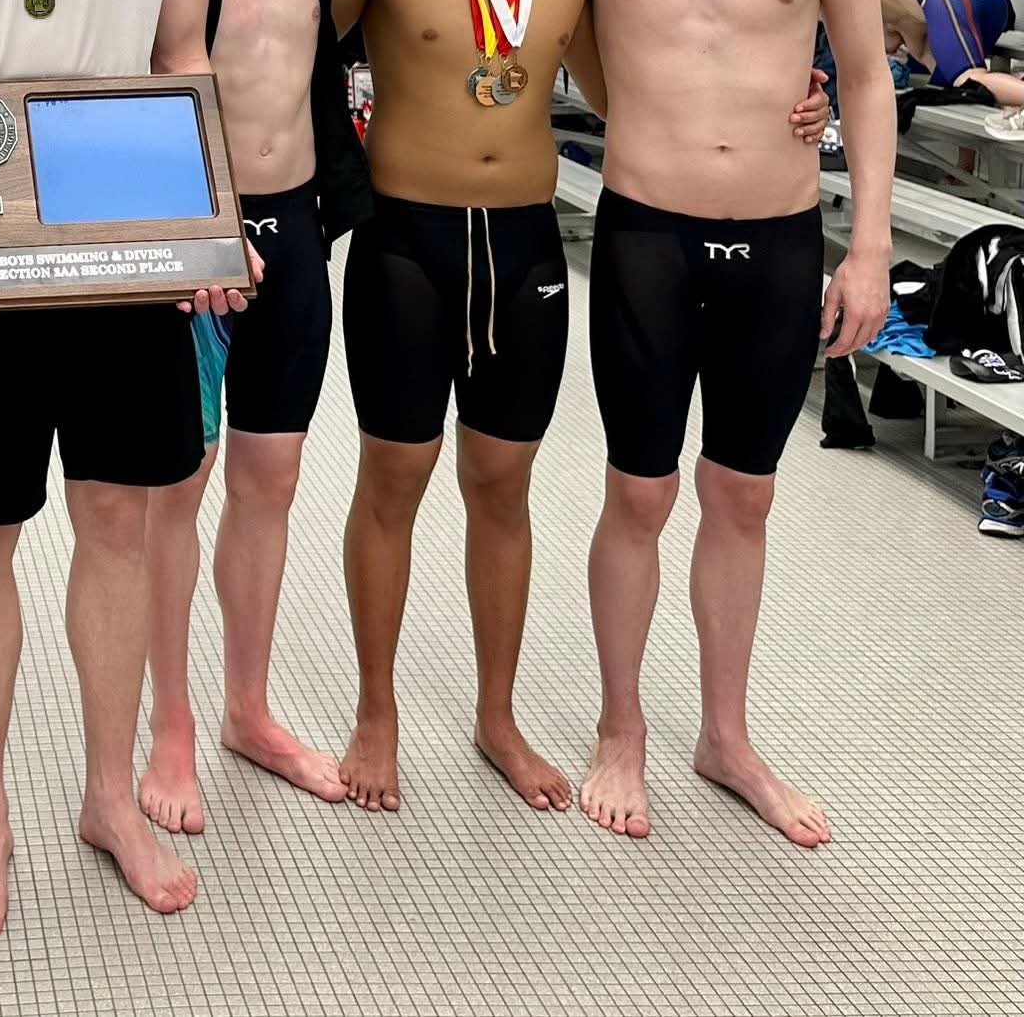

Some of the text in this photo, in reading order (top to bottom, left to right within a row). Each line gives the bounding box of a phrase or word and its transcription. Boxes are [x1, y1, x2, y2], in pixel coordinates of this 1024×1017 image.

[243, 218, 279, 236] YR
[36, 251, 109, 265] SWIMMING
[111, 250, 122, 261] &
[124, 248, 173, 261] DIVING
[704, 242, 751, 259] TYR
[80, 263, 136, 276] SECOND
[139, 261, 184, 274] PLACE
